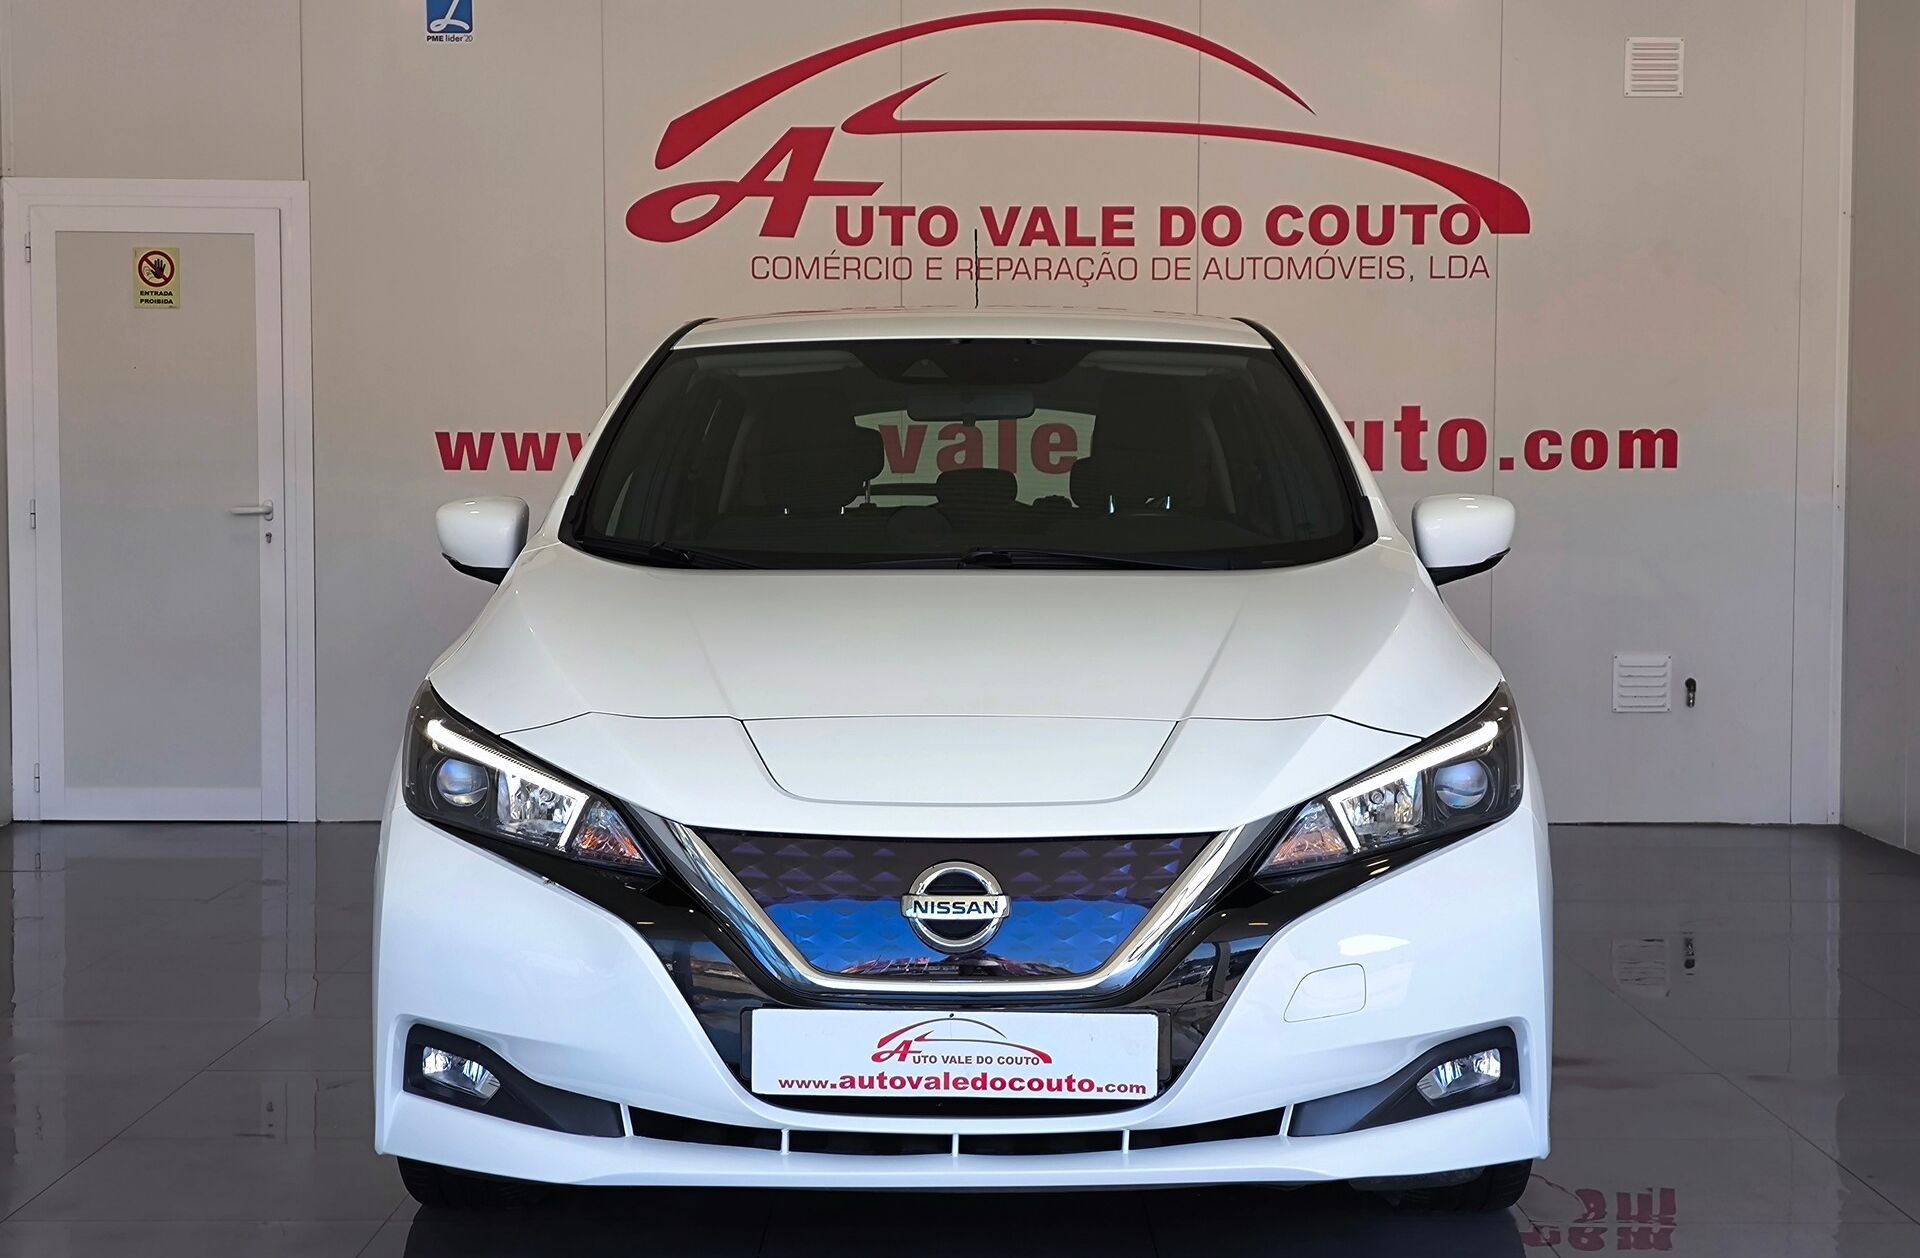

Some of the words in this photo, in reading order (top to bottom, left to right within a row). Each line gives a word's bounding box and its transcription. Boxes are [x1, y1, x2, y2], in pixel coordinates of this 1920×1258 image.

[625, 126, 959, 248] AUTO
[979, 205, 1136, 248] VALE
[1158, 205, 1242, 248] DO
[1265, 203, 1482, 247] COUTO
[751, 250, 912, 280] COMÉRCIO
[925, 256, 943, 281] E
[955, 251, 1138, 288] REPARAÇÃO
[1151, 257, 1191, 281] DE
[1202, 249, 1415, 282] AUTOMÓVEIS,
[1429, 255, 1490, 279] LDA
[913, 900, 998, 915] NISSAN
[871, 1039, 938, 1065] AUTO
[941, 1055, 973, 1065] VALE
[976, 1056, 994, 1065] DO
[997, 1055, 1040, 1066] COUTO
[778, 1071, 1147, 1095] www.autovaledocouto.com
